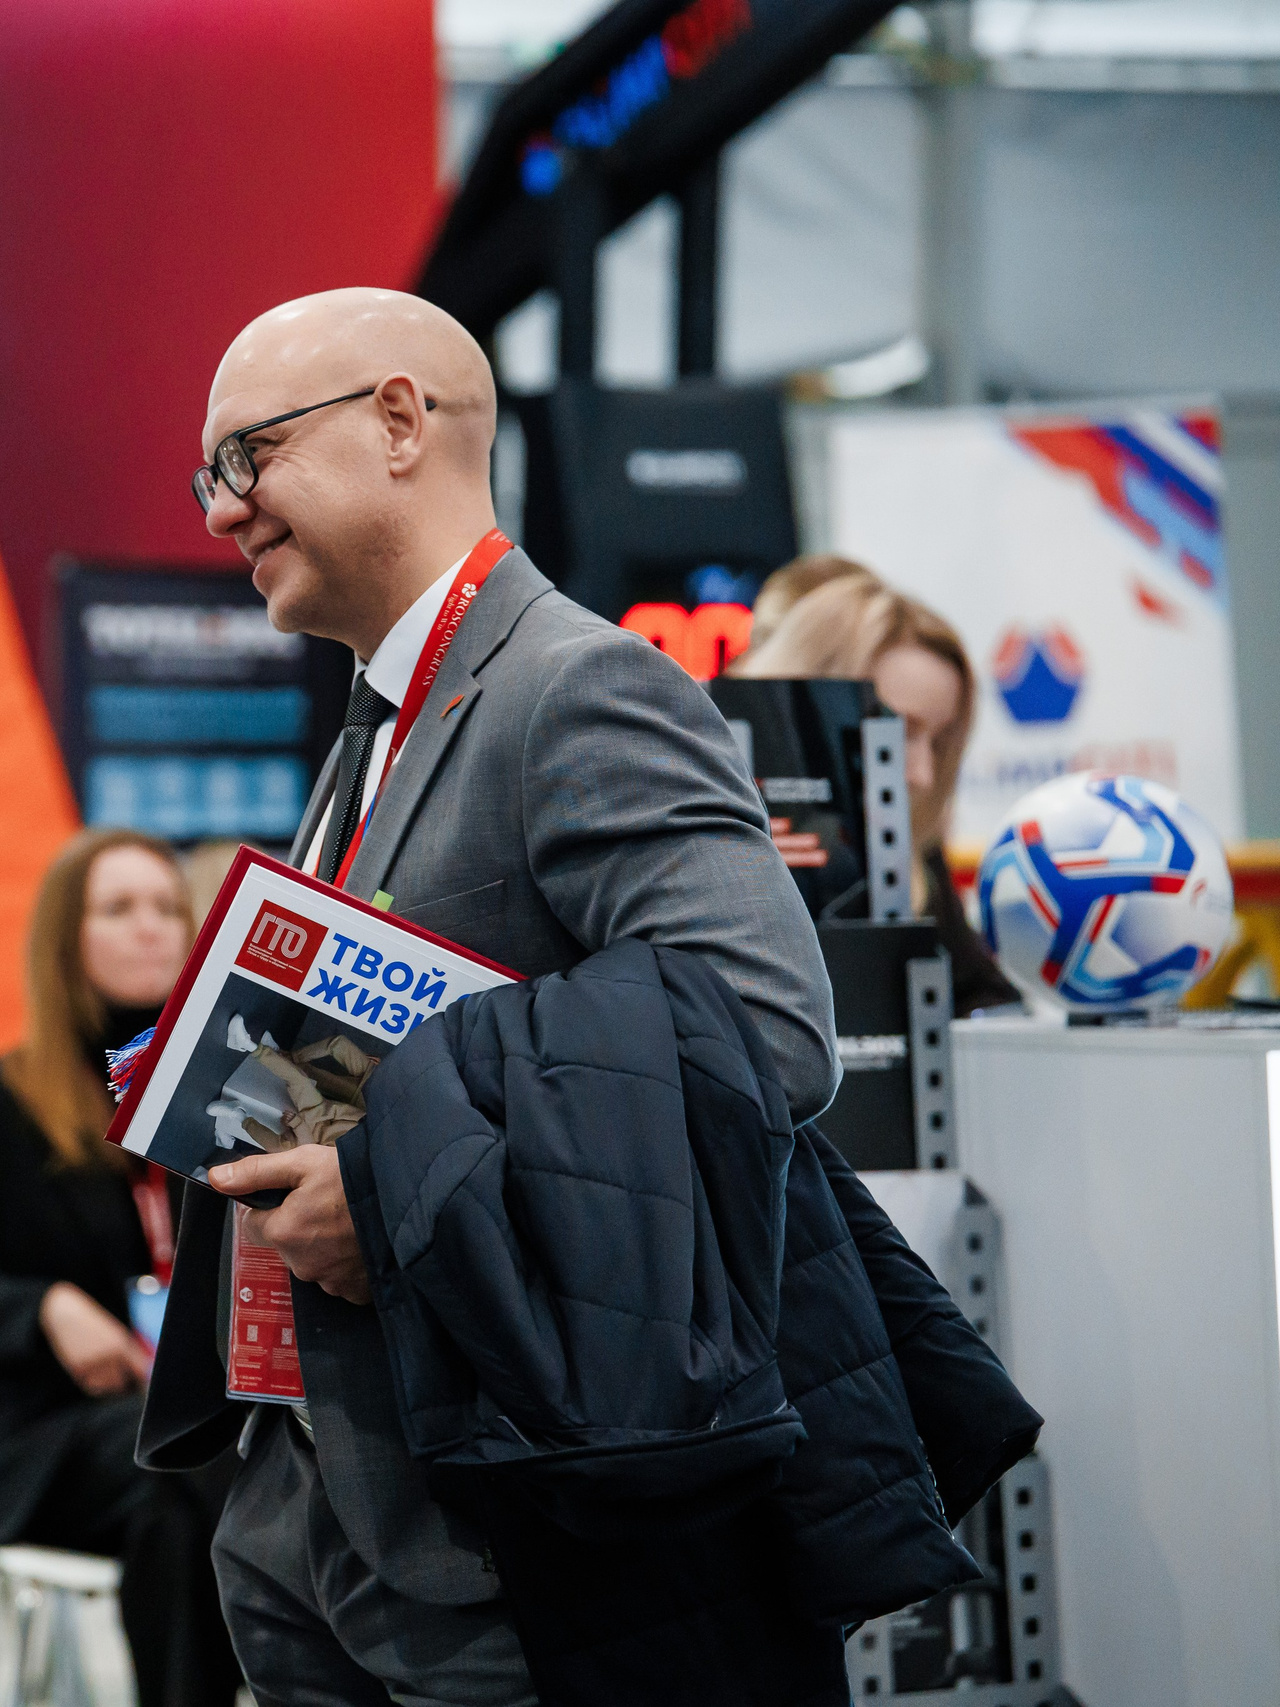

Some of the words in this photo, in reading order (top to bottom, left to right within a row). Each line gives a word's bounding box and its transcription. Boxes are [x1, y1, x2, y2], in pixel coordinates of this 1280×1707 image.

[422, 597, 470, 687] ROSCONGRESS
[251, 911, 308, 959] ГТО
[331, 932, 448, 1009] ТВОЙ
